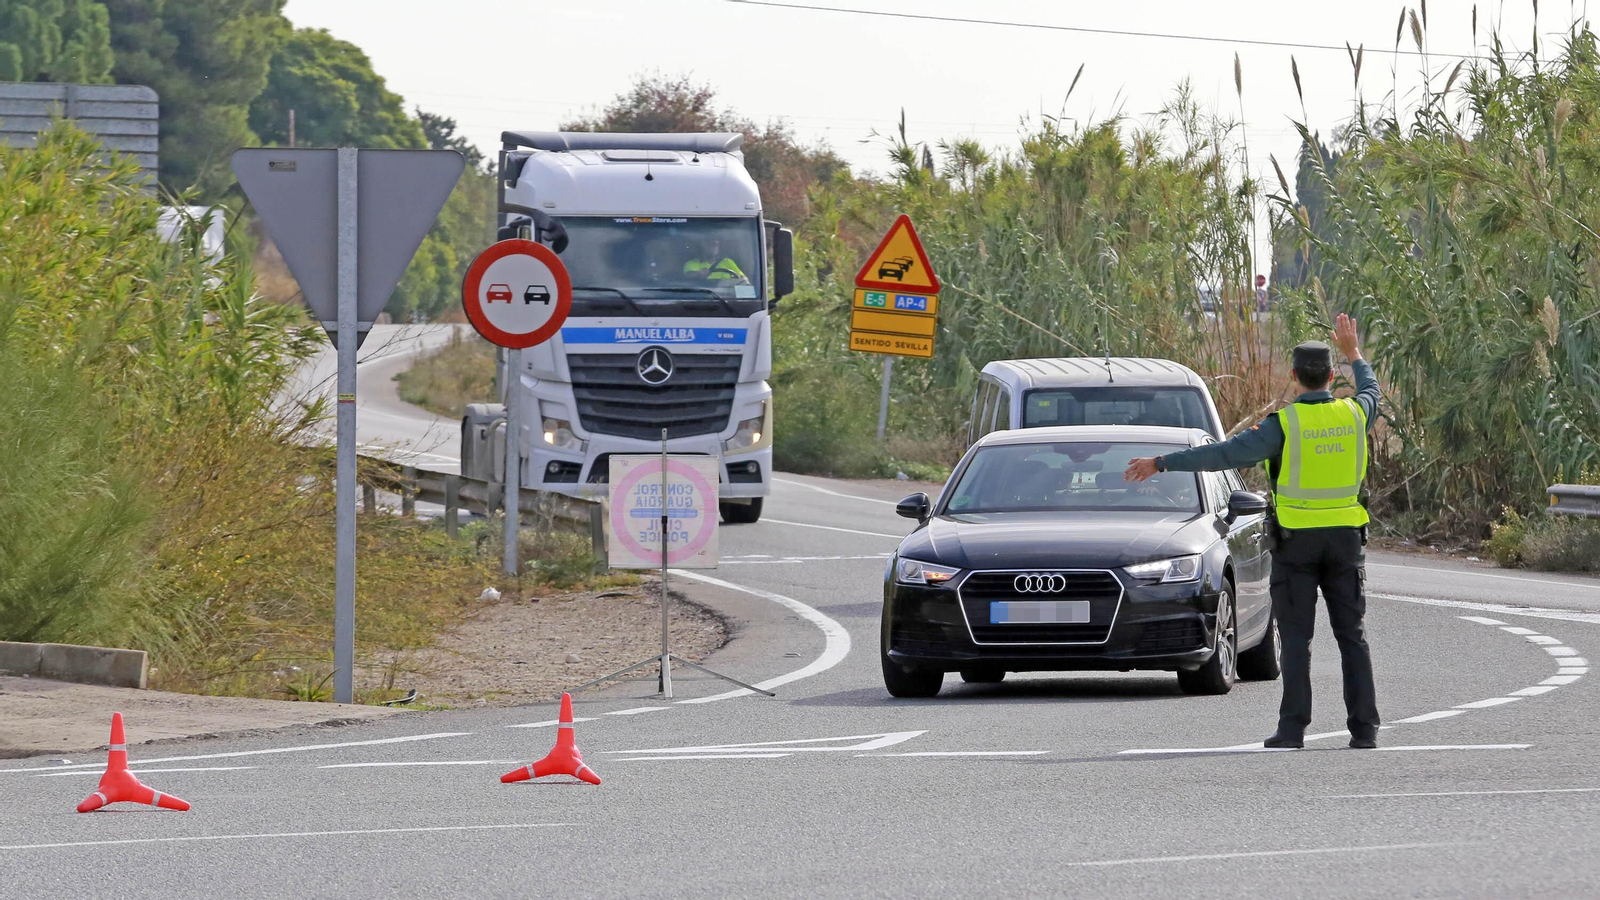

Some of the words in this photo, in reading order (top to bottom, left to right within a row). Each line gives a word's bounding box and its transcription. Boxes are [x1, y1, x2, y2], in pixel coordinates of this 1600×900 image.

[865, 293, 885, 306] E-5
[897, 296, 925, 309] AP-4
[614, 328, 661, 339] MANUEL
[663, 328, 695, 339] ALBA
[854, 338, 891, 347] SENTIDO
[895, 341, 928, 350] SEVILLA
[1303, 425, 1355, 439] GUARDIA
[1315, 442, 1345, 455] CIVIL
